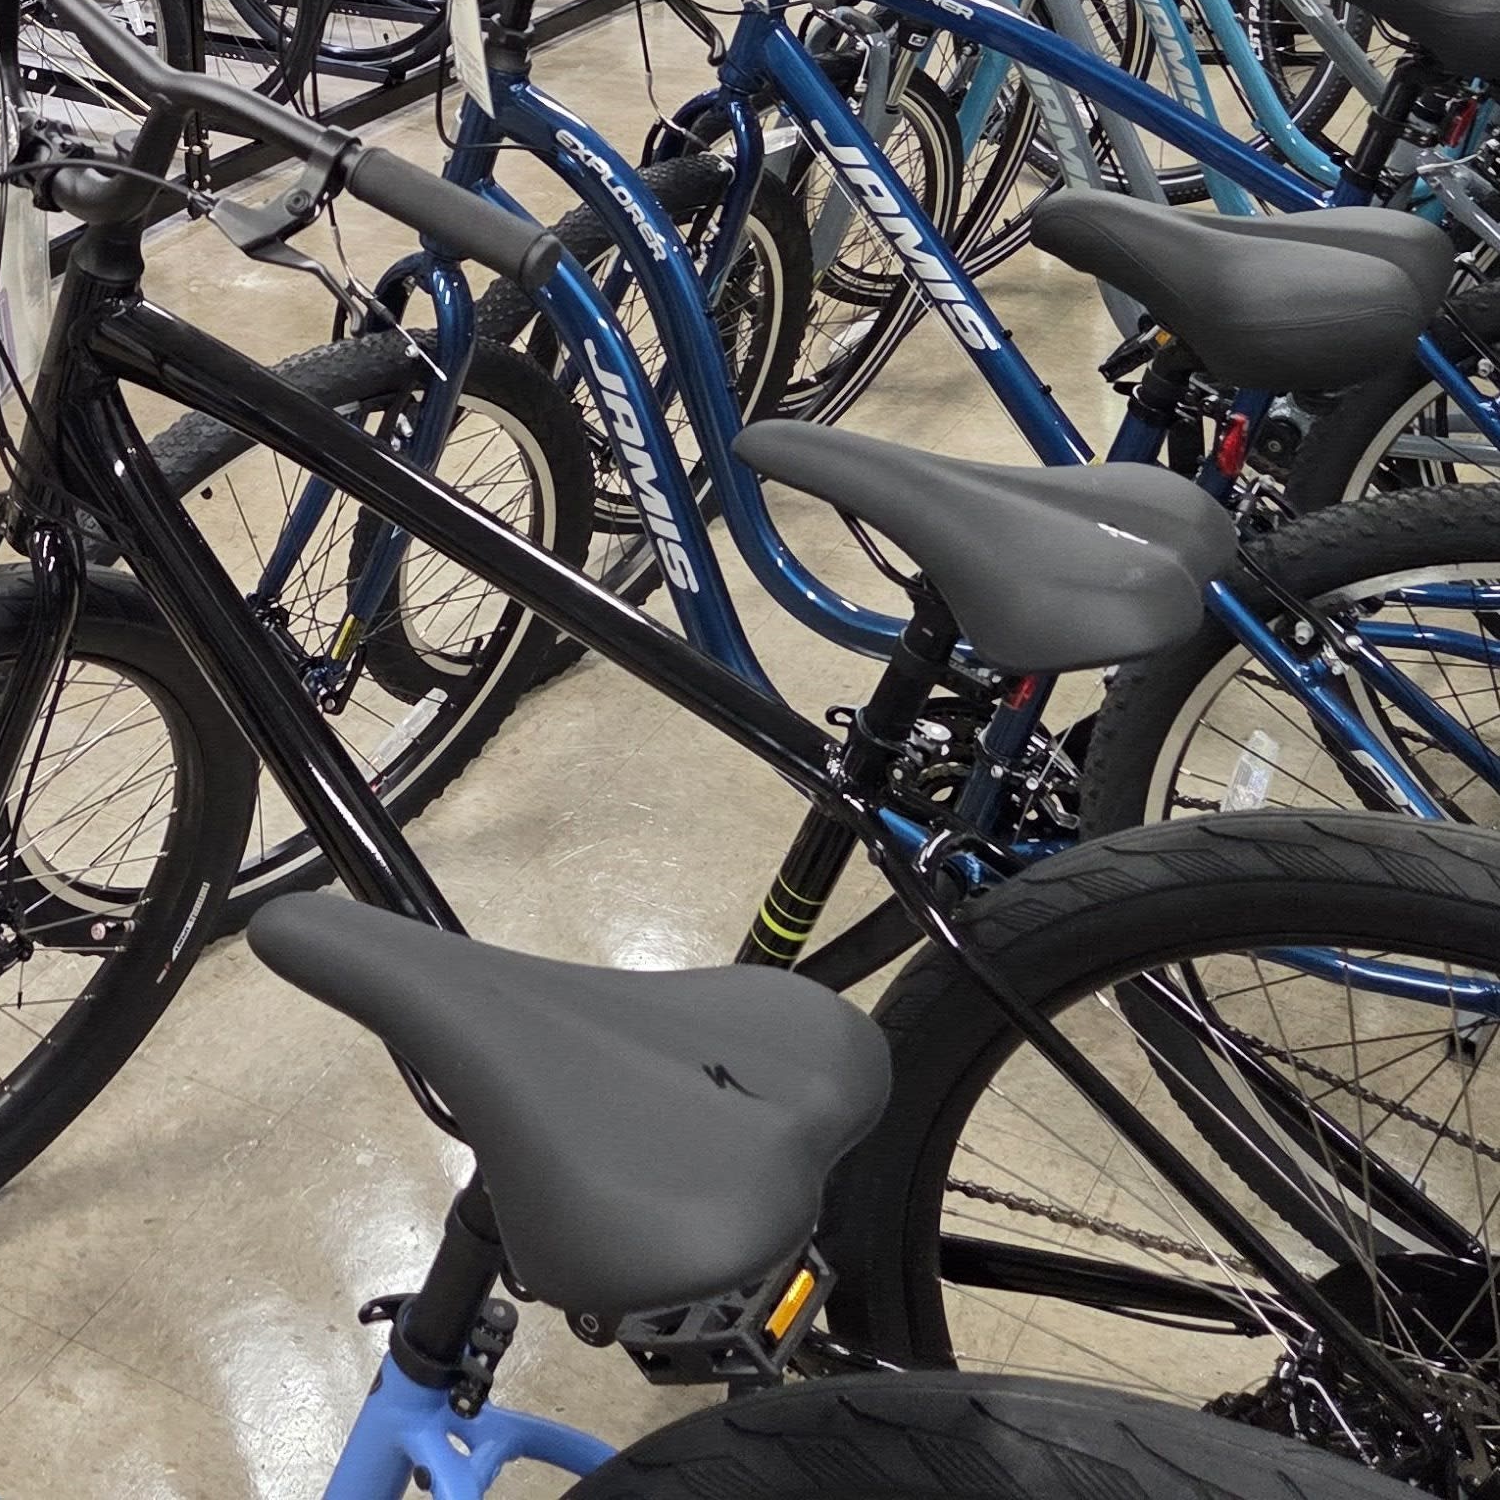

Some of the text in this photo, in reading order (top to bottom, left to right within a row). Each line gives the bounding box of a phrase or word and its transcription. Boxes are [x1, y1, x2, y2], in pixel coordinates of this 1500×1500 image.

[555, 129, 668, 263] EXPLORER
[811, 118, 1002, 353] JAMIS
[583, 338, 700, 595] JAMIS
